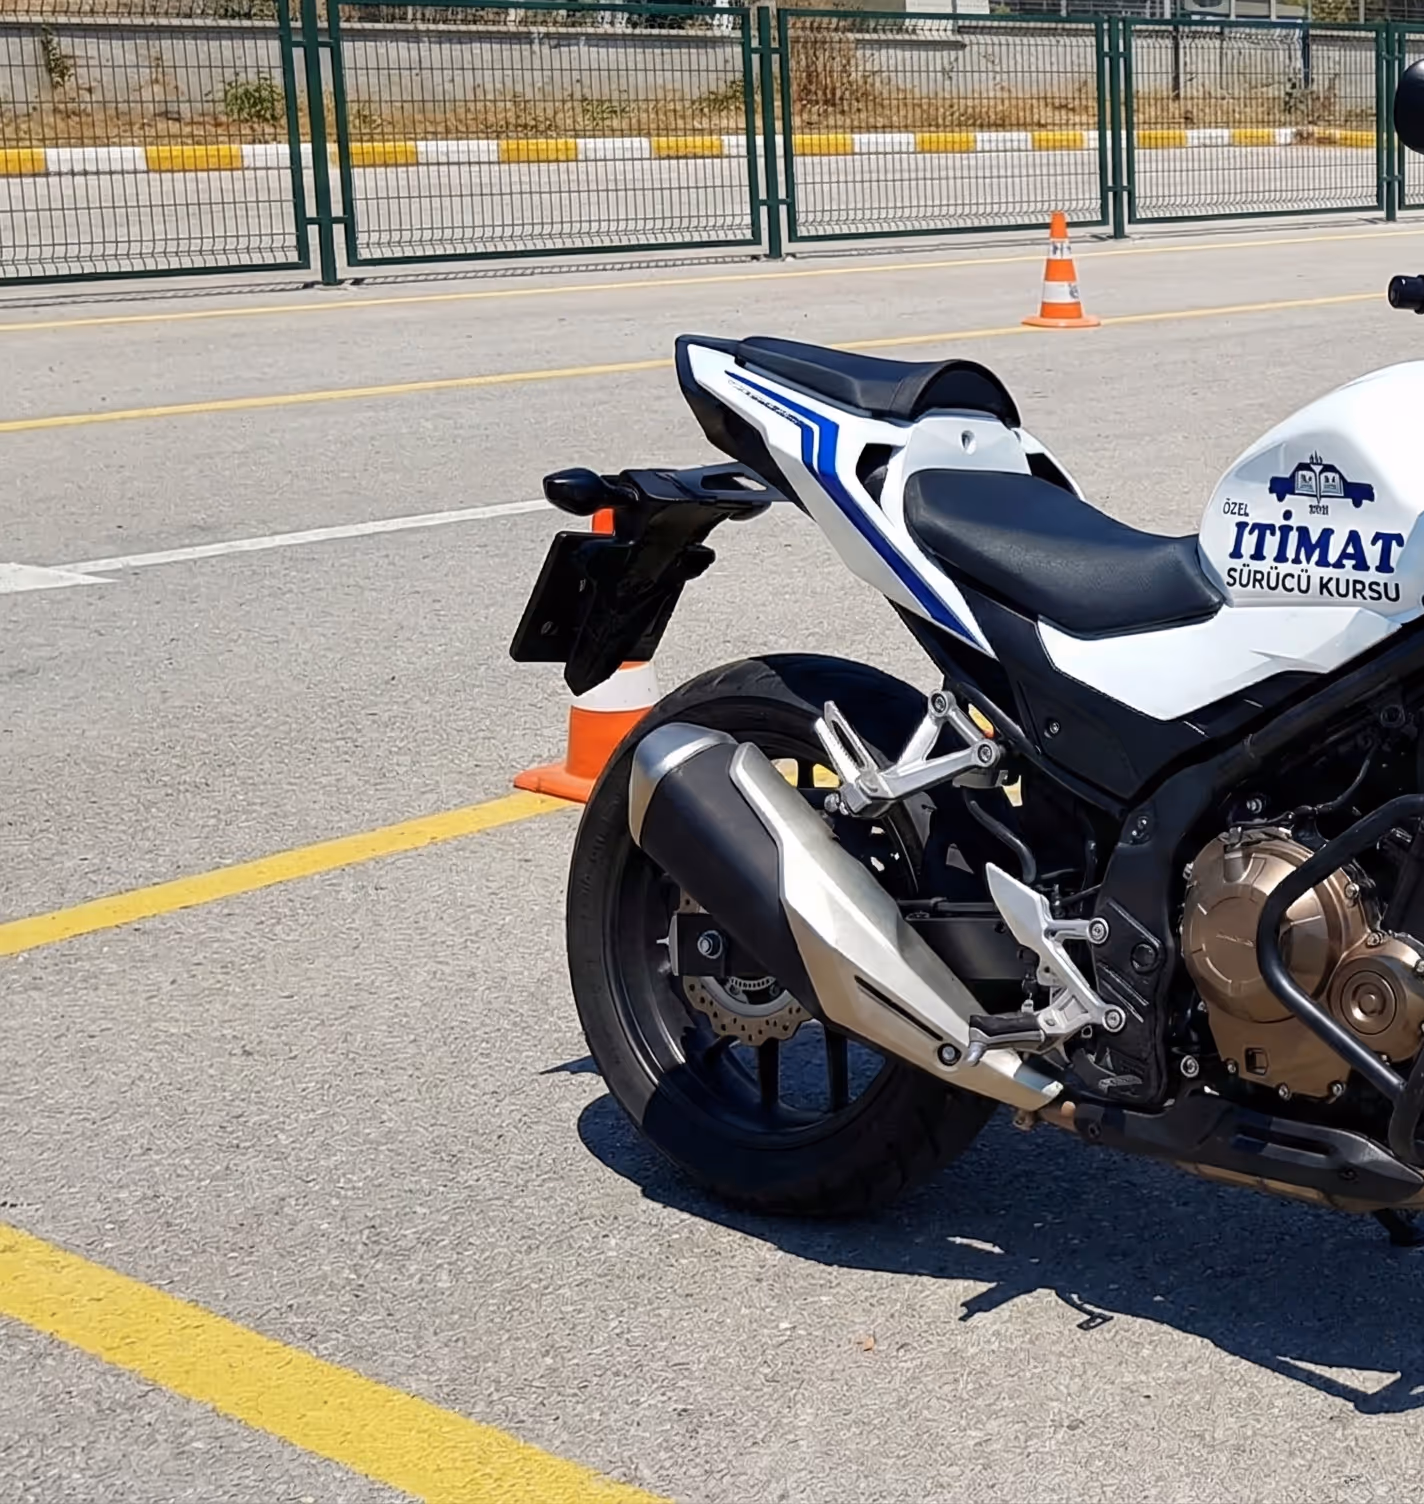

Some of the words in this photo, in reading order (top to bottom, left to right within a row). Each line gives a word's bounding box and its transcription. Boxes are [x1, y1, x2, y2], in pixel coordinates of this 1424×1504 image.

[1223, 498, 1250, 517] ÖZEL
[1226, 563, 1311, 594] SÜRÜCÜ
[1319, 576, 1401, 602] KURSU
